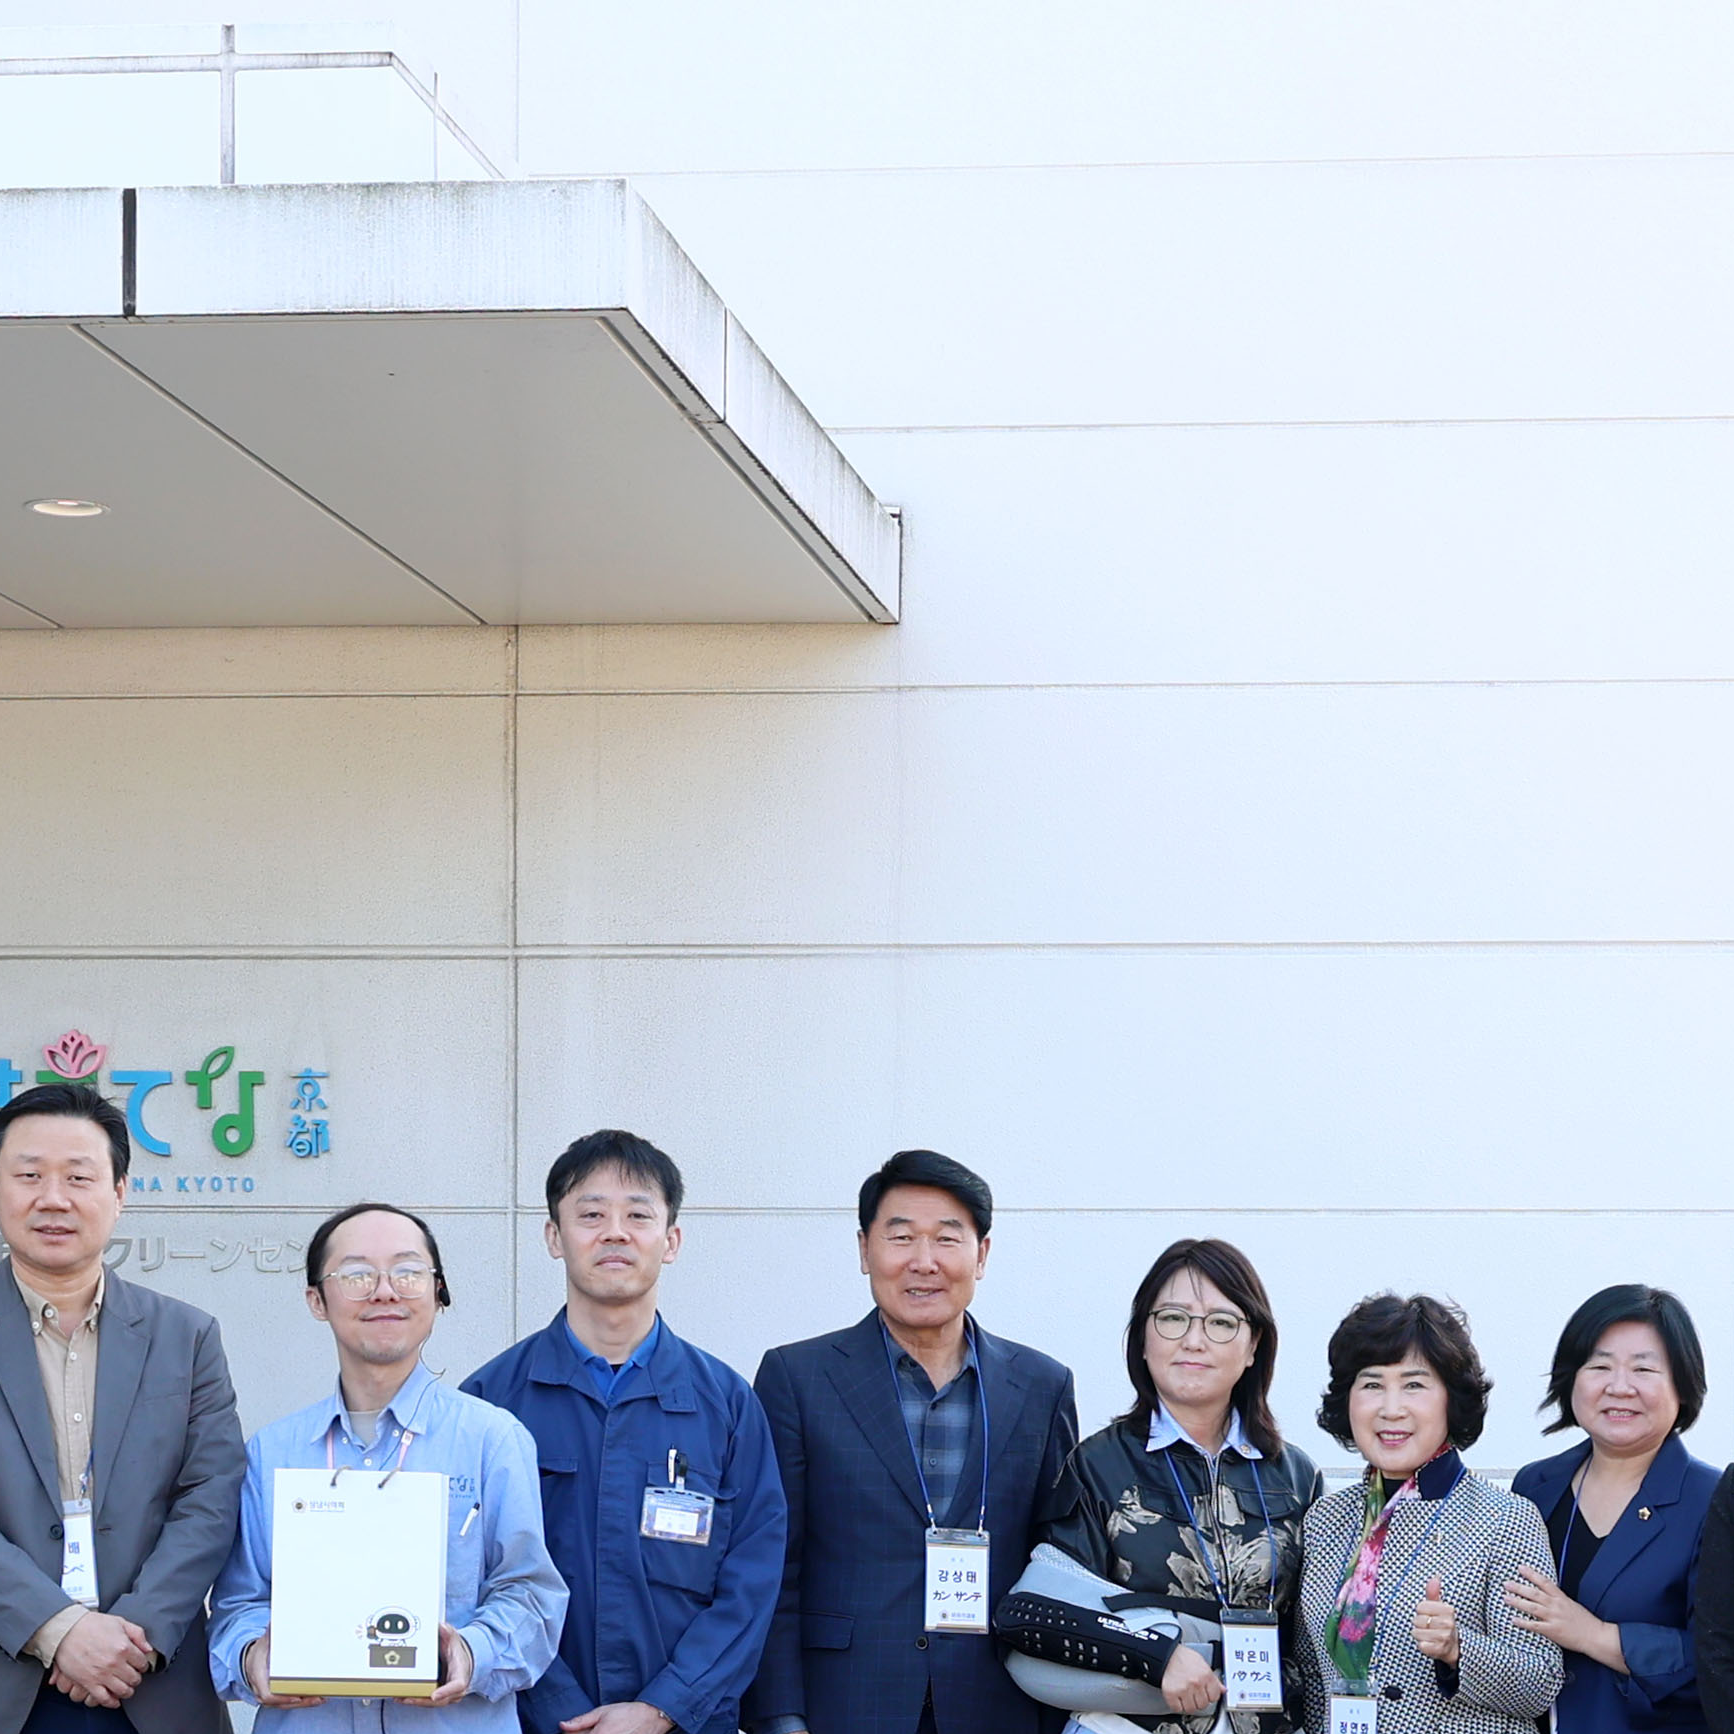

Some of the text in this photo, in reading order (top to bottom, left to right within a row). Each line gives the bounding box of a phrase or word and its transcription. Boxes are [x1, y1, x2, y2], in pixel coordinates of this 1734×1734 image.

[286, 1067, 331, 1158] 京都
[176, 1176, 255, 1194] KYOTO
[938, 1570, 977, 1584] 강상태
[1234, 1650, 1270, 1663] 박은미
